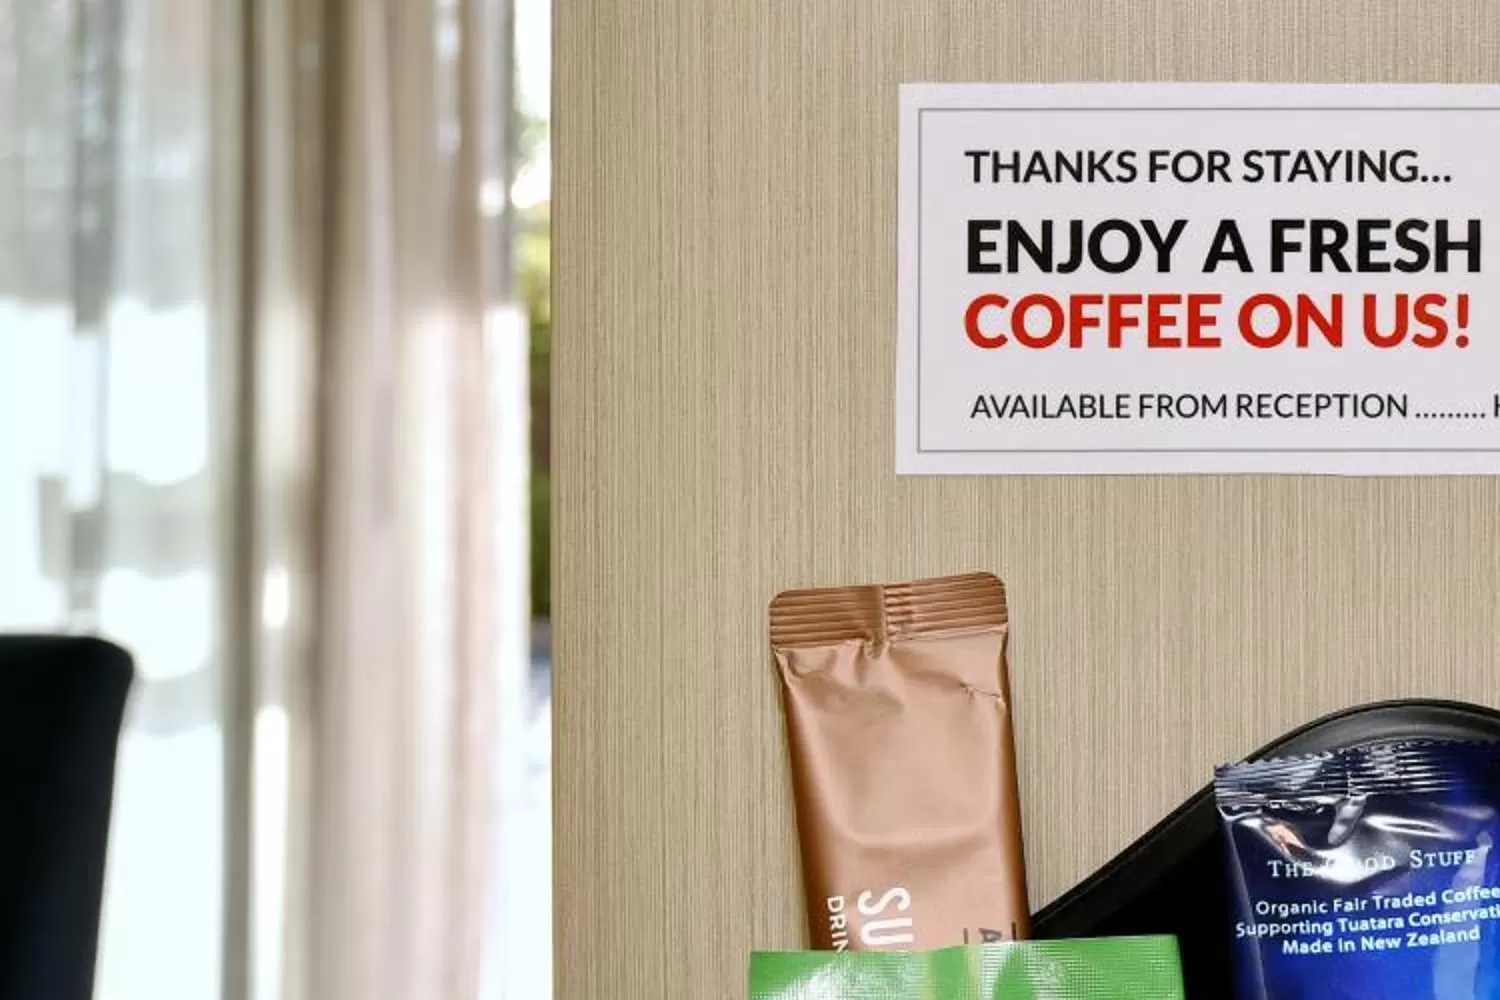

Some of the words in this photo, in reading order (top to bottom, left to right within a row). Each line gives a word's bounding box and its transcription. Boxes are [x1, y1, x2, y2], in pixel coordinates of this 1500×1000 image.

[965, 150, 1137, 183] THANKS
[1149, 150, 1231, 183] FOR
[1242, 150, 1452, 183] STAYING...
[967, 219, 1188, 273] ENJOY
[1202, 219, 1254, 273] A
[1270, 219, 1481, 273] FRESH
[964, 294, 1222, 349] COFFEE
[1237, 294, 1343, 349] ON
[1363, 294, 1470, 349] US!
[971, 394, 1131, 420] AVAILABLE
[1139, 394, 1228, 419] FROM
[1237, 394, 1407, 420] RECEPTION
[1267, 860, 1315, 878] THE
[1410, 850, 1476, 868] STUFF
[857, 887, 914, 947] SU
[1255, 900, 1327, 918] Organic
[1333, 899, 1368, 913] Fair
[1372, 892, 1437, 909] Traded
[827, 895, 850, 953] DRIN
[1235, 919, 1334, 939] Supporting
[1338, 916, 1404, 933] Tuatara
[1282, 939, 1332, 955] Made
[1361, 935, 1402, 951] New
[1406, 926, 1481, 947] Zealand
